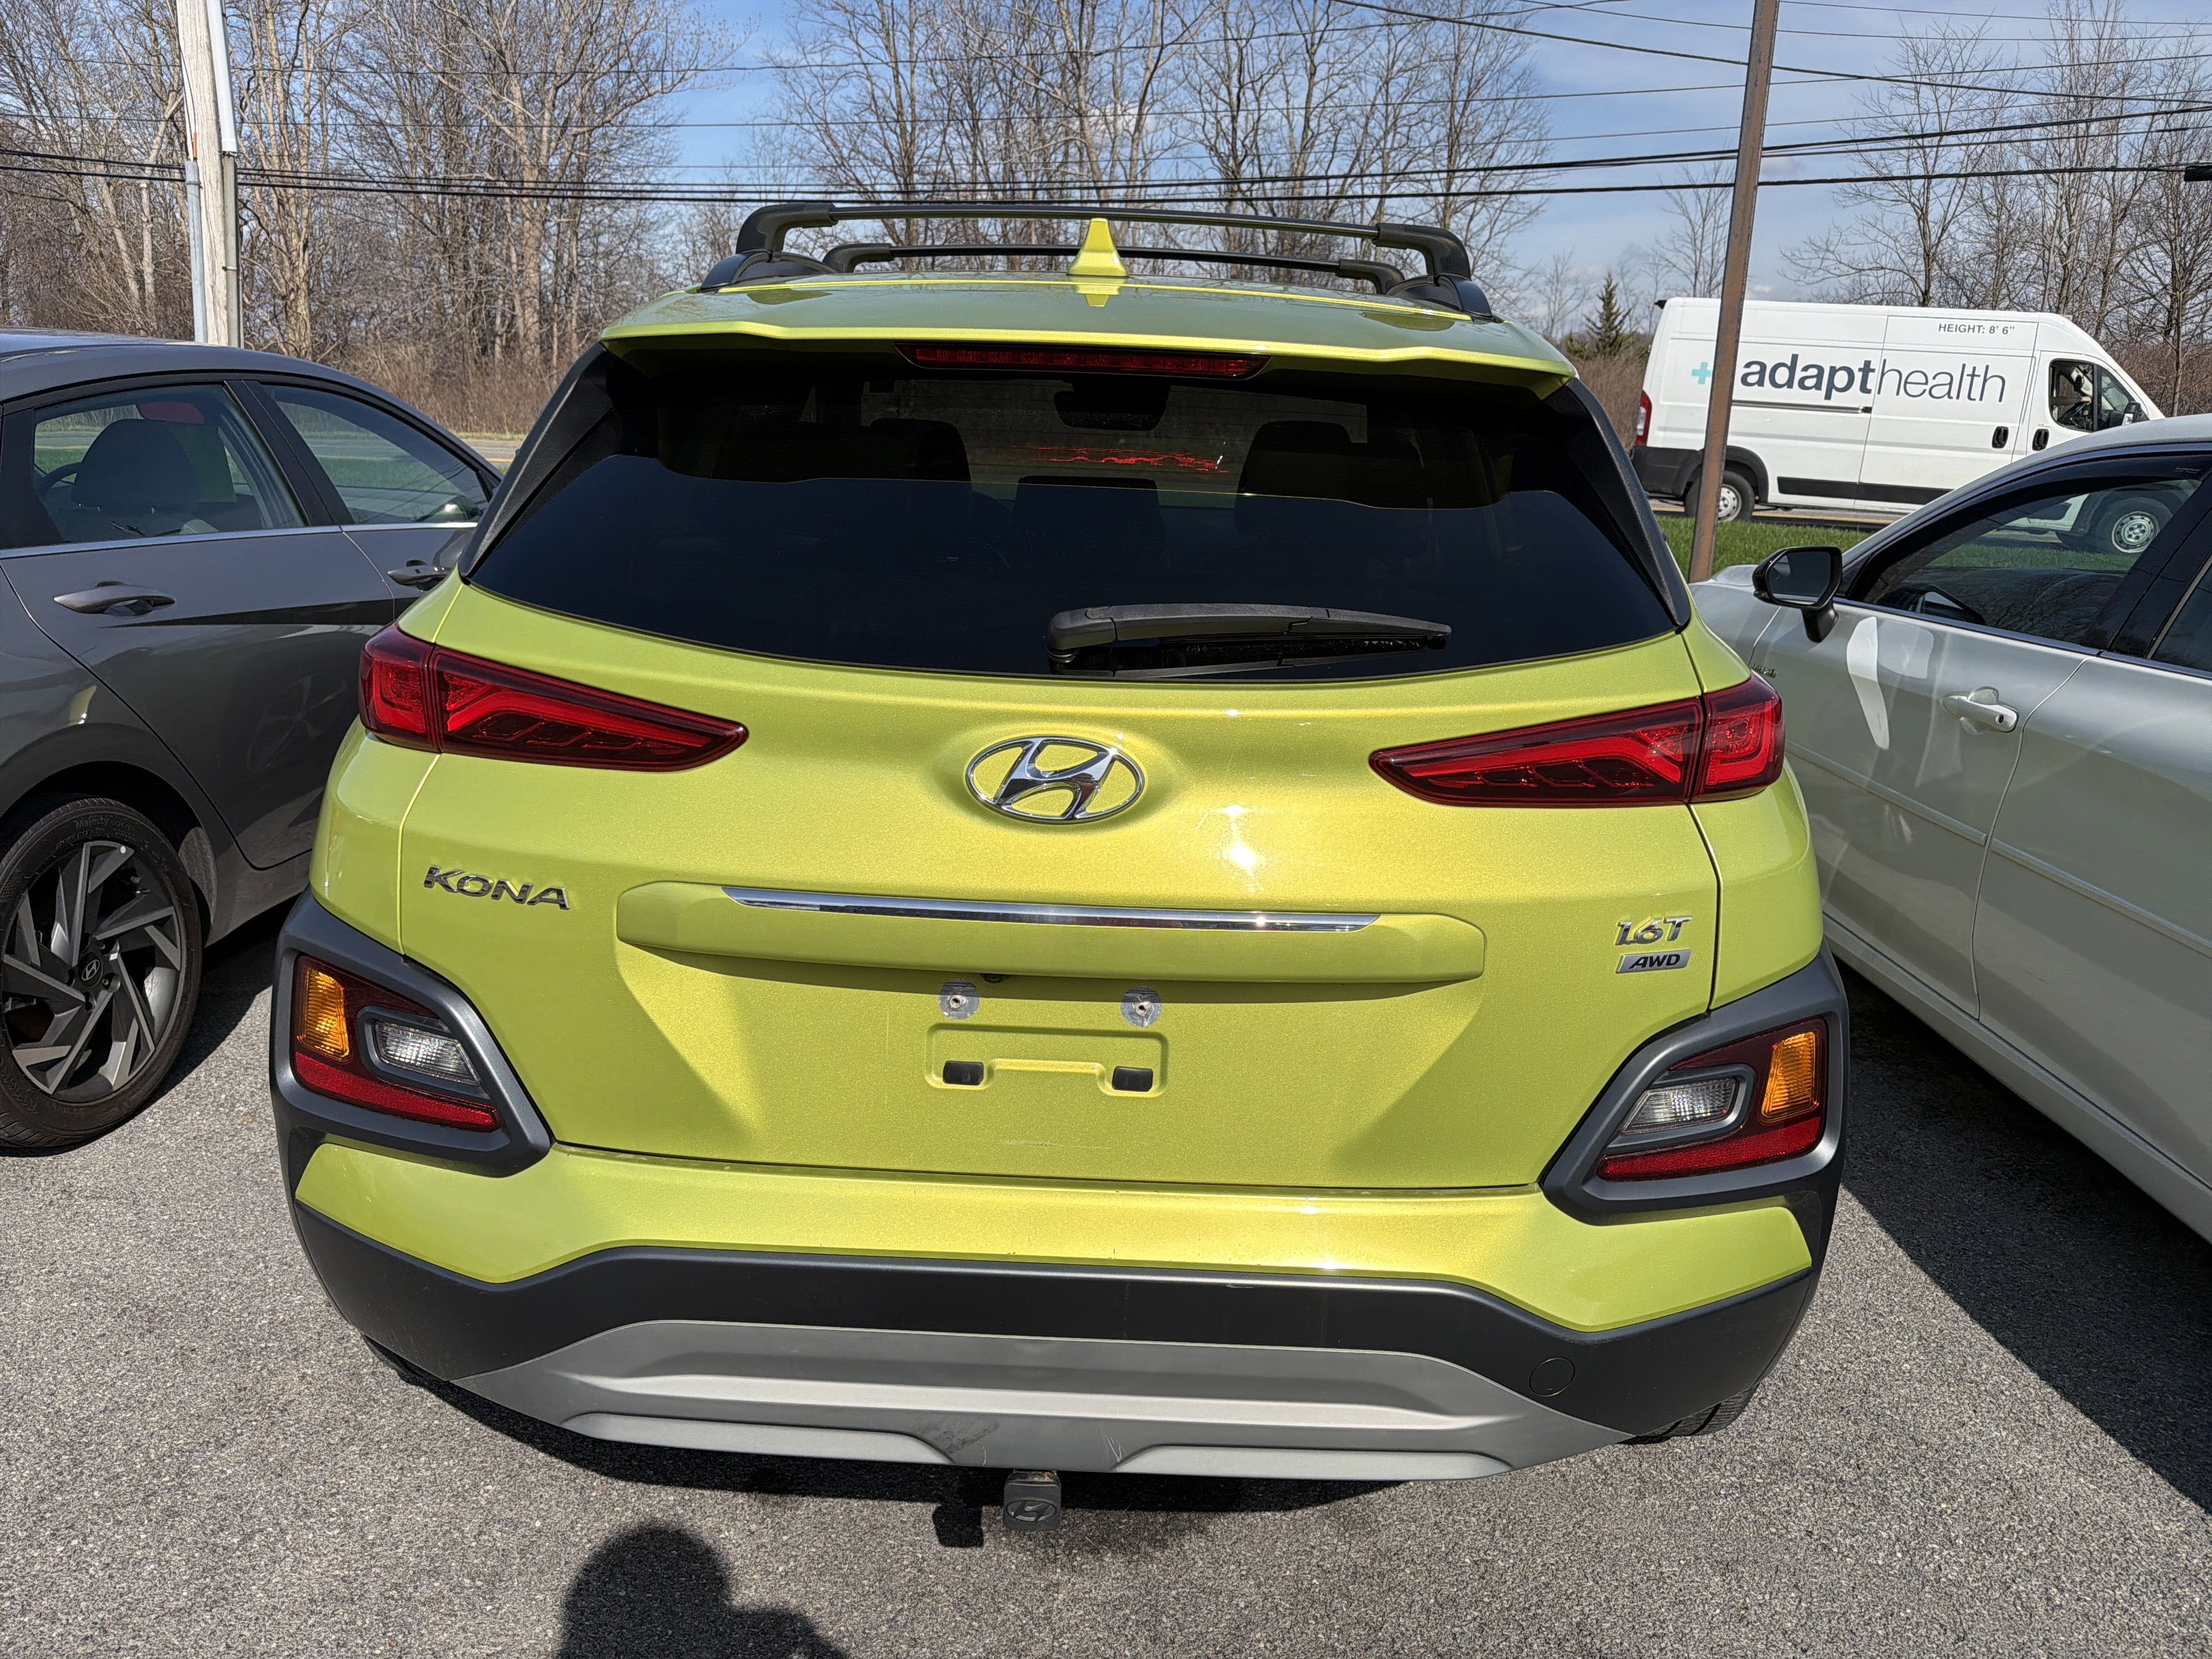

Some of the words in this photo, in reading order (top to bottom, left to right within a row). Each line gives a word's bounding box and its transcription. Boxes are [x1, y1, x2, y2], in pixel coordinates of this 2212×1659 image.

[1938, 323, 1985, 334] HEIGHT:
[1740, 353, 2006, 403] adapthealth
[424, 865, 571, 910] KONA
[1615, 915, 1693, 945] 1.6T
[1628, 953, 1680, 969] AWD
